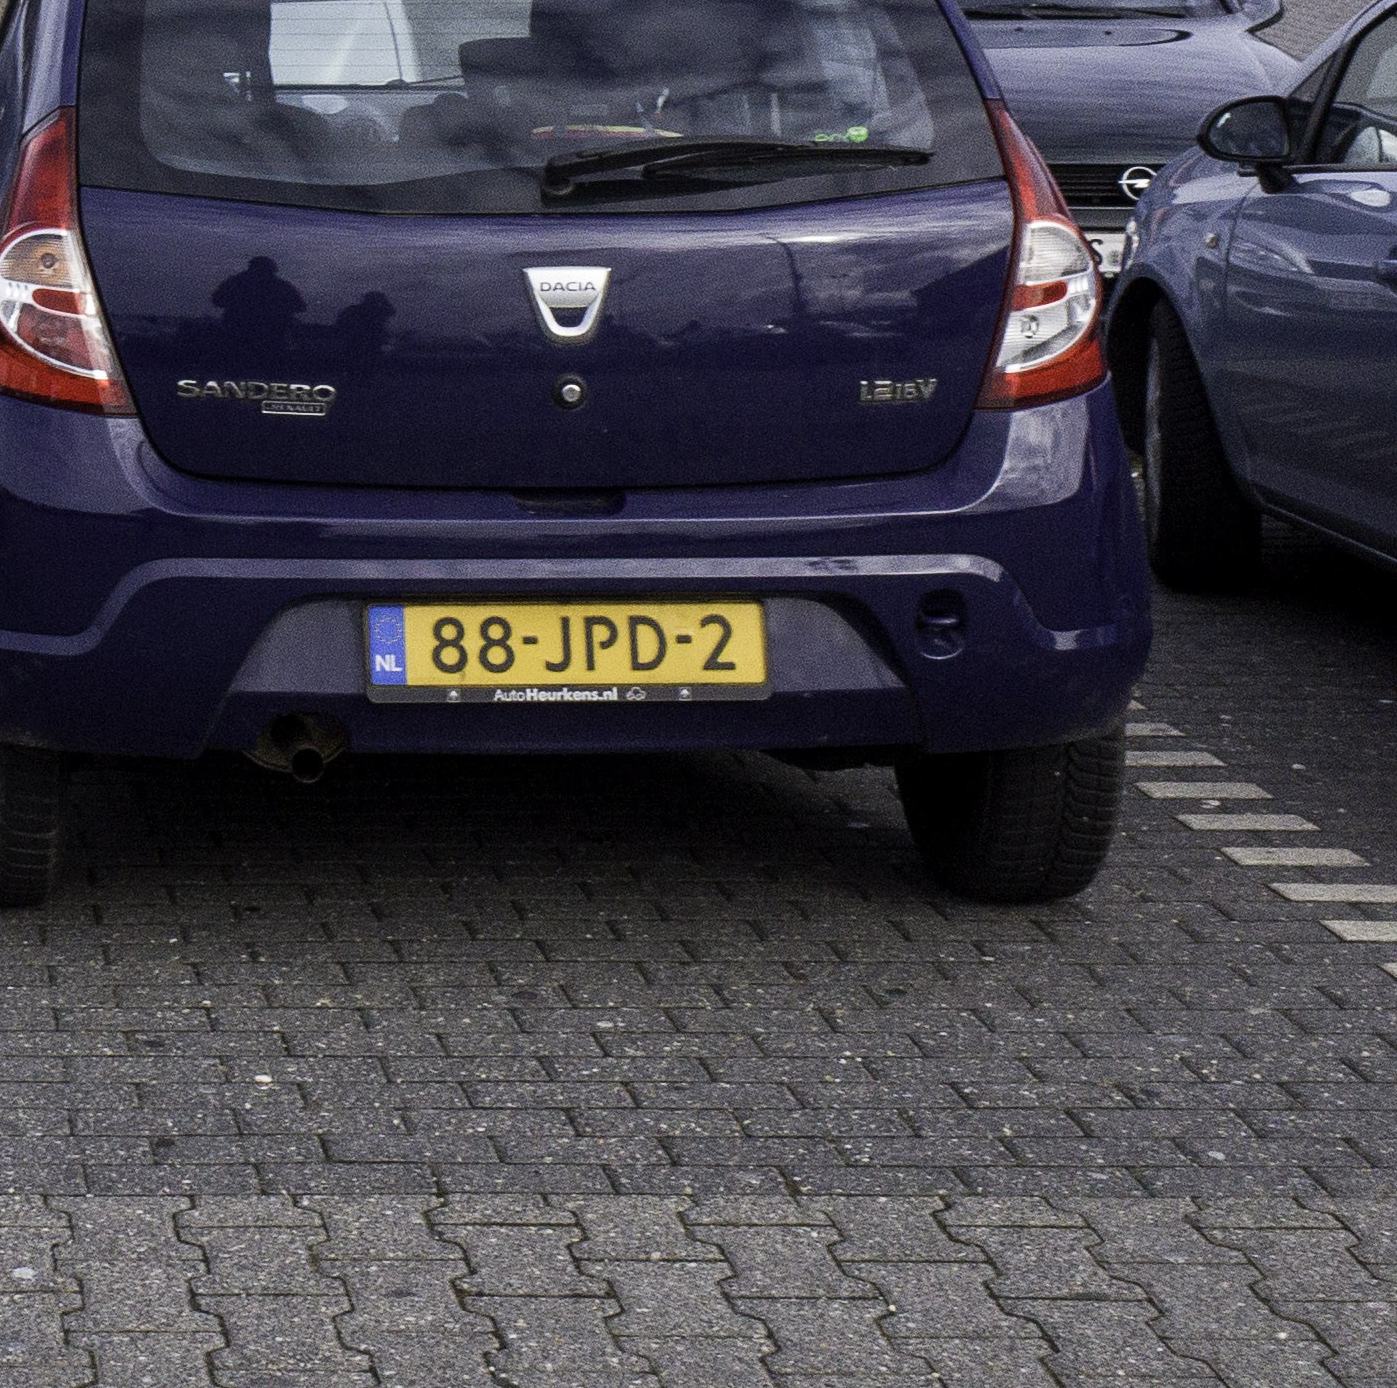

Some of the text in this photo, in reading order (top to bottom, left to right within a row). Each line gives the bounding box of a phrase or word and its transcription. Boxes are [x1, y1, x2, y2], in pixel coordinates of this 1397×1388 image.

[540, 281, 597, 292] DACIA
[177, 380, 337, 401] SANDERO
[374, 614, 736, 674] 88-JPD-2 NL
[493, 687, 618, 702] AutoHeurkens.nl
